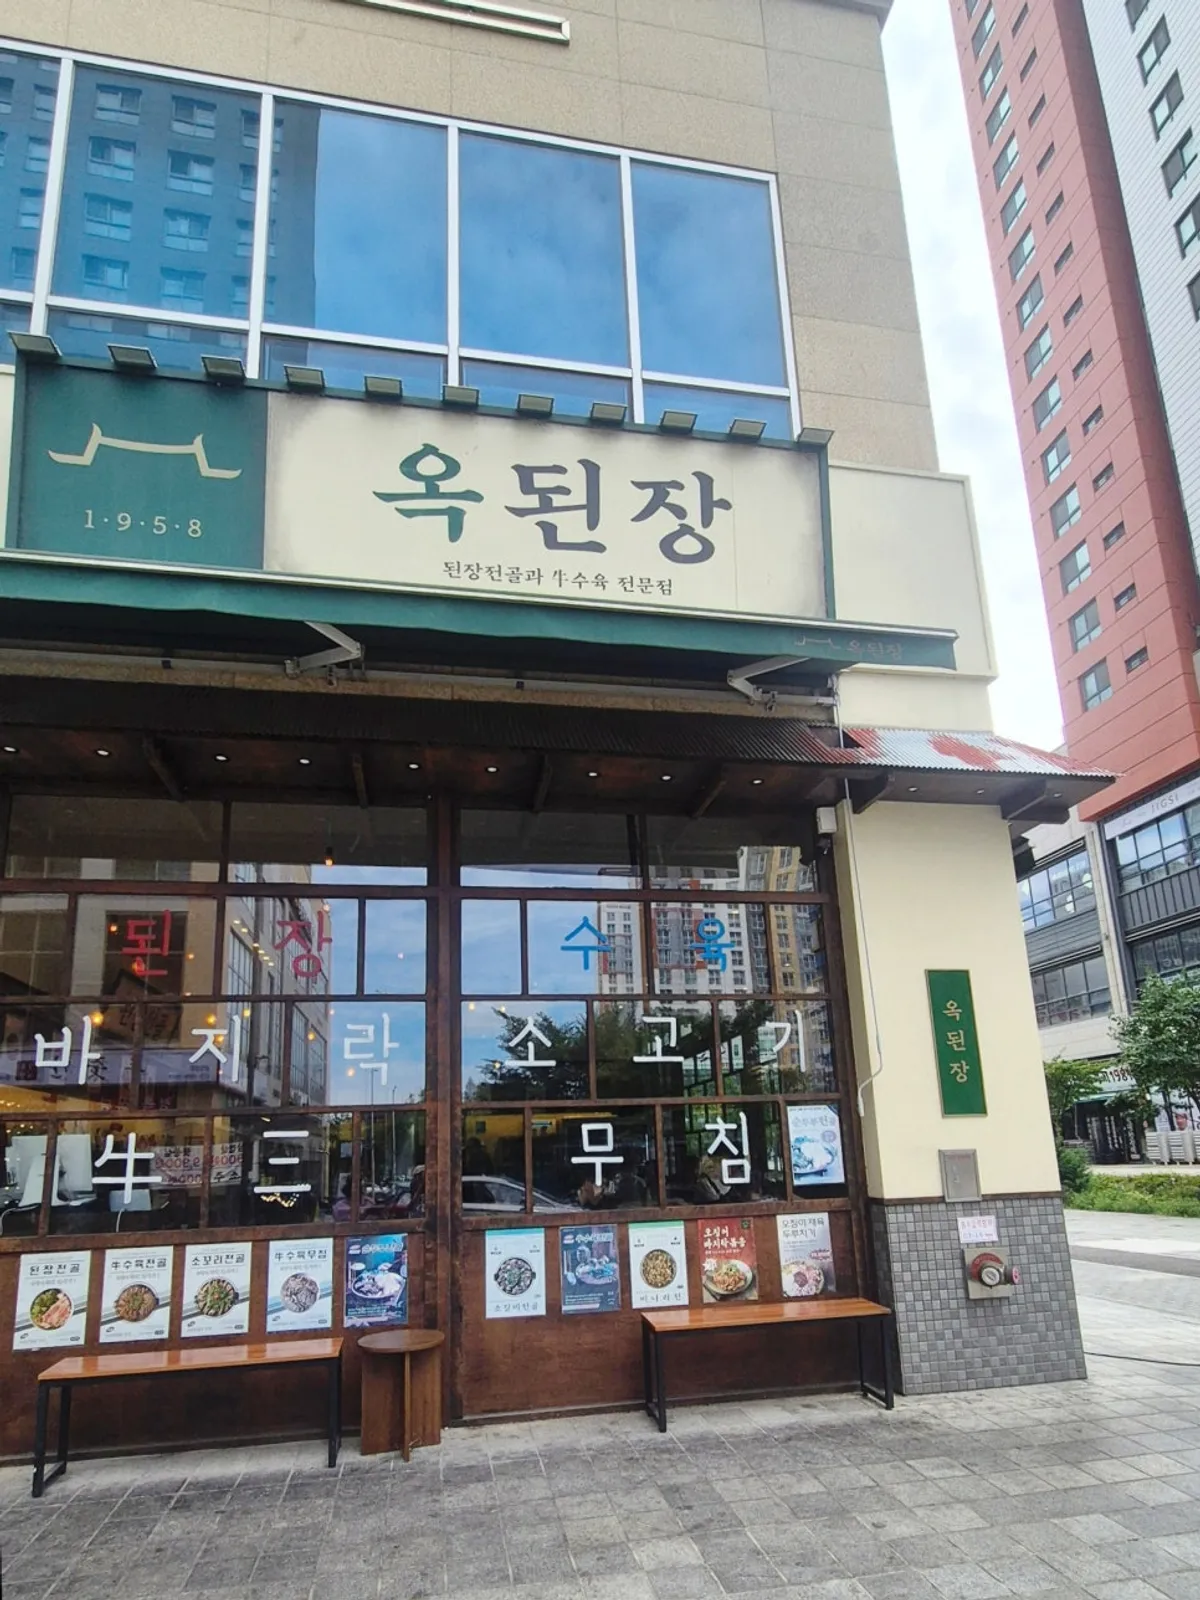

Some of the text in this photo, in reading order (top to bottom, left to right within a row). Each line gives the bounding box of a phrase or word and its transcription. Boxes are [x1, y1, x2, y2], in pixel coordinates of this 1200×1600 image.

[372, 443, 732, 565] 옥된장
[443, 560, 544, 586] 된장전골과
[617, 575, 673, 596] 전문점
[122, 909, 333, 978] 된장
[560, 916, 737, 973] 수육
[34, 1012, 400, 1086] 바지락
[504, 1009, 807, 1073] 소고기
[941, 999, 970, 1083] 옥된장
[571, 1111, 752, 1187] 무침
